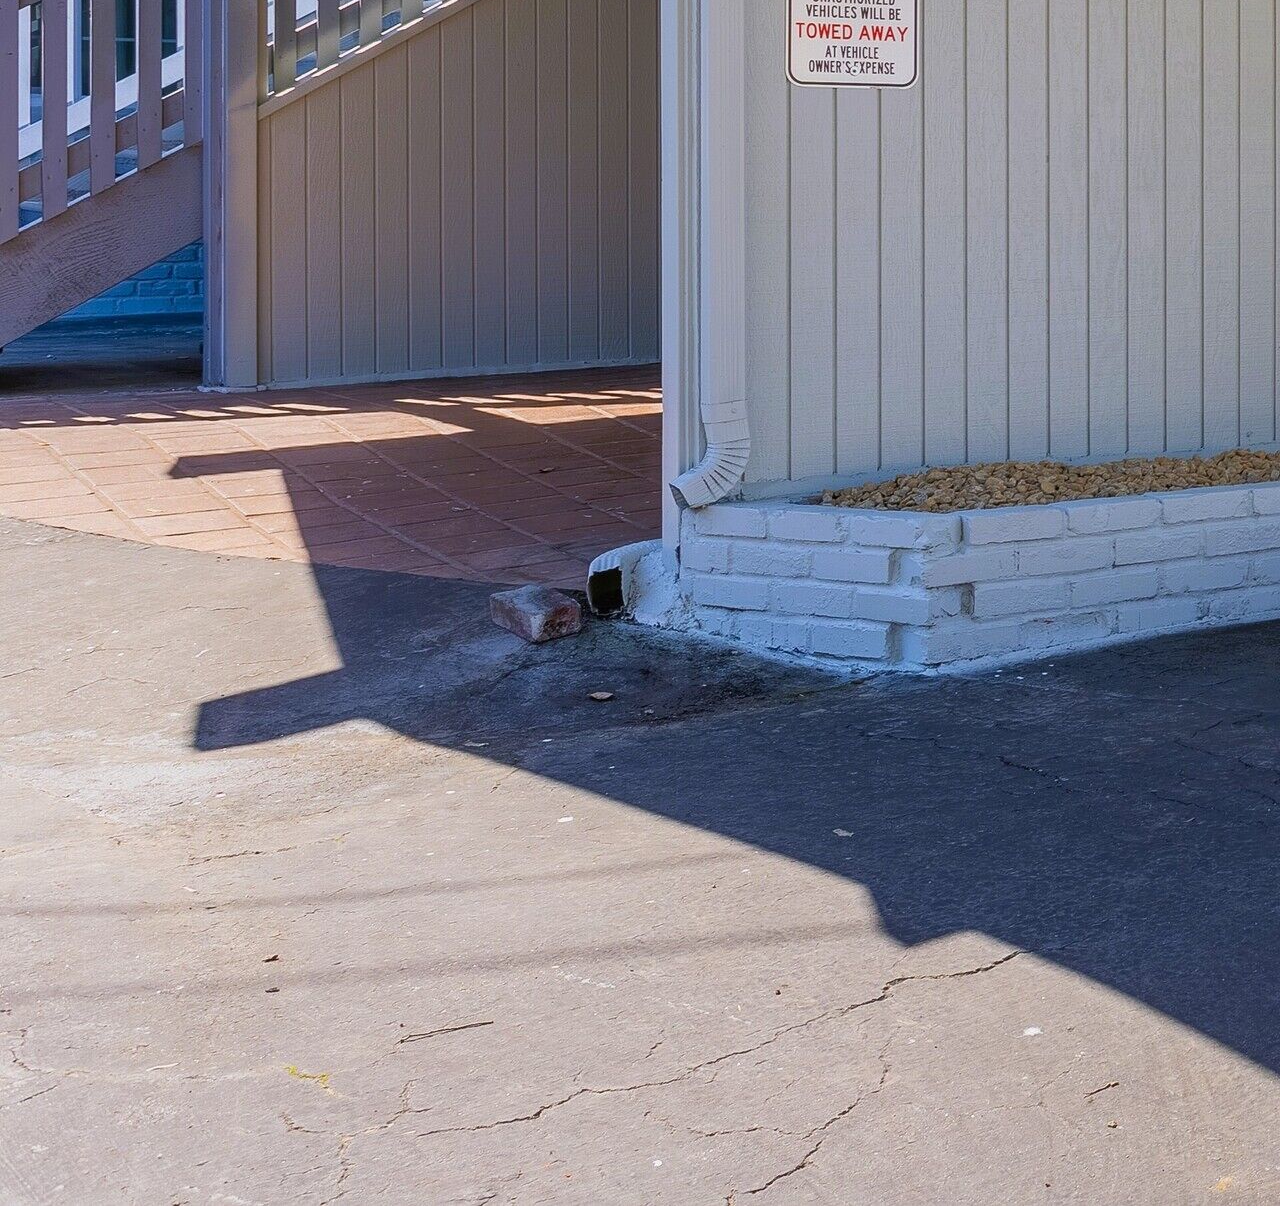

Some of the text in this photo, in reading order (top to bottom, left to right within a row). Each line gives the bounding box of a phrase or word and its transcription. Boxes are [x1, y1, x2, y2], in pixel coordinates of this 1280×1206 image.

[805, 4, 902, 21] VEHICLES WILL BE
[796, 22, 909, 42] TOWED AWAY
[824, 45, 879, 60] AT VEHICLE
[808, 59, 851, 74] OWNER'S
